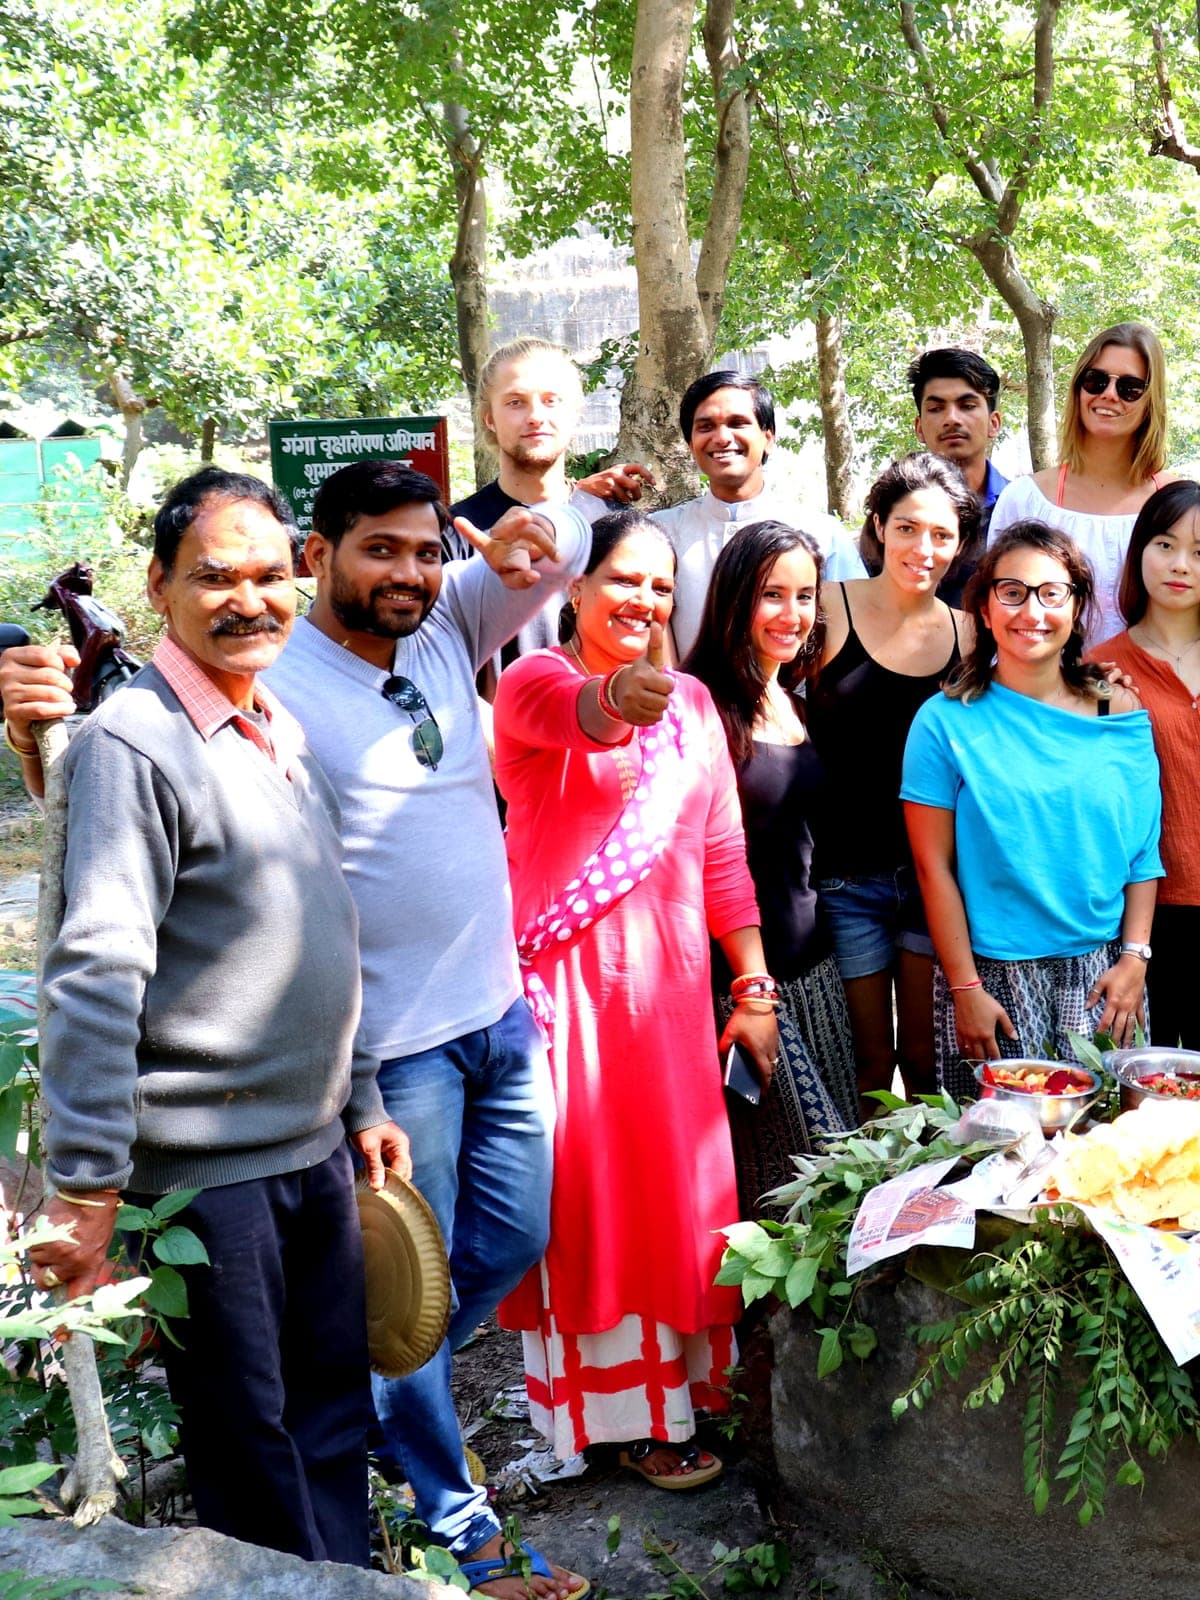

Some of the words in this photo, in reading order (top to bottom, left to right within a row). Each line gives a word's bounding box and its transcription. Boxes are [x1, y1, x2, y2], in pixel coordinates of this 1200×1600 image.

[281, 433, 317, 456] गंगा
[319, 430, 384, 459] वृक्षारोपण
[385, 428, 436, 452] अभियान
